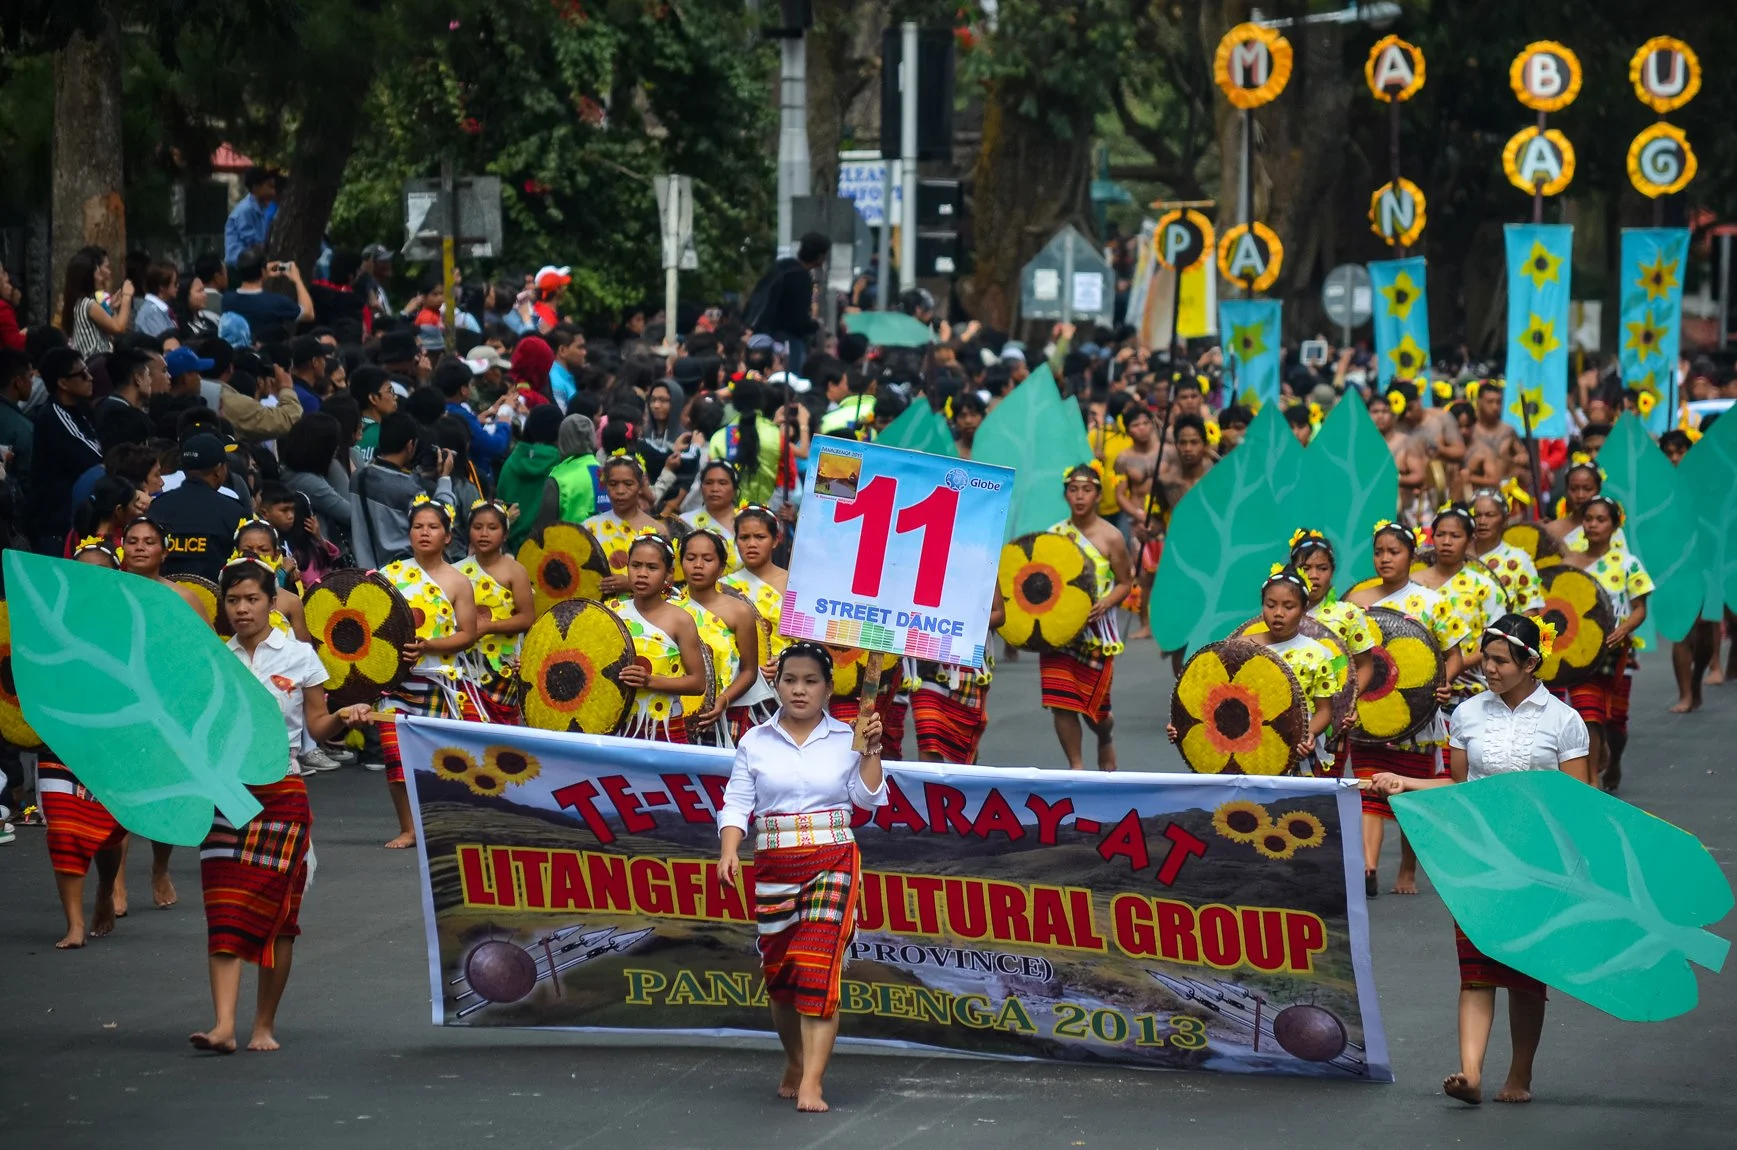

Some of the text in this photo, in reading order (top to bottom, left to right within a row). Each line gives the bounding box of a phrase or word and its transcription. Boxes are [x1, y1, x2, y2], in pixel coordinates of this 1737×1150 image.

[1231, 40, 1686, 97] M A B U
[1166, 134, 1680, 278] P A N A G
[970, 477, 1001, 491] Globe
[168, 537, 207, 552] OLICE
[834, 475, 960, 608] 11
[815, 598, 965, 637] STREET DANCE
[850, 774, 1209, 888] ARAY-AT
[1111, 893, 1327, 974] GROUP
[1053, 1002, 1209, 1050] 2013
